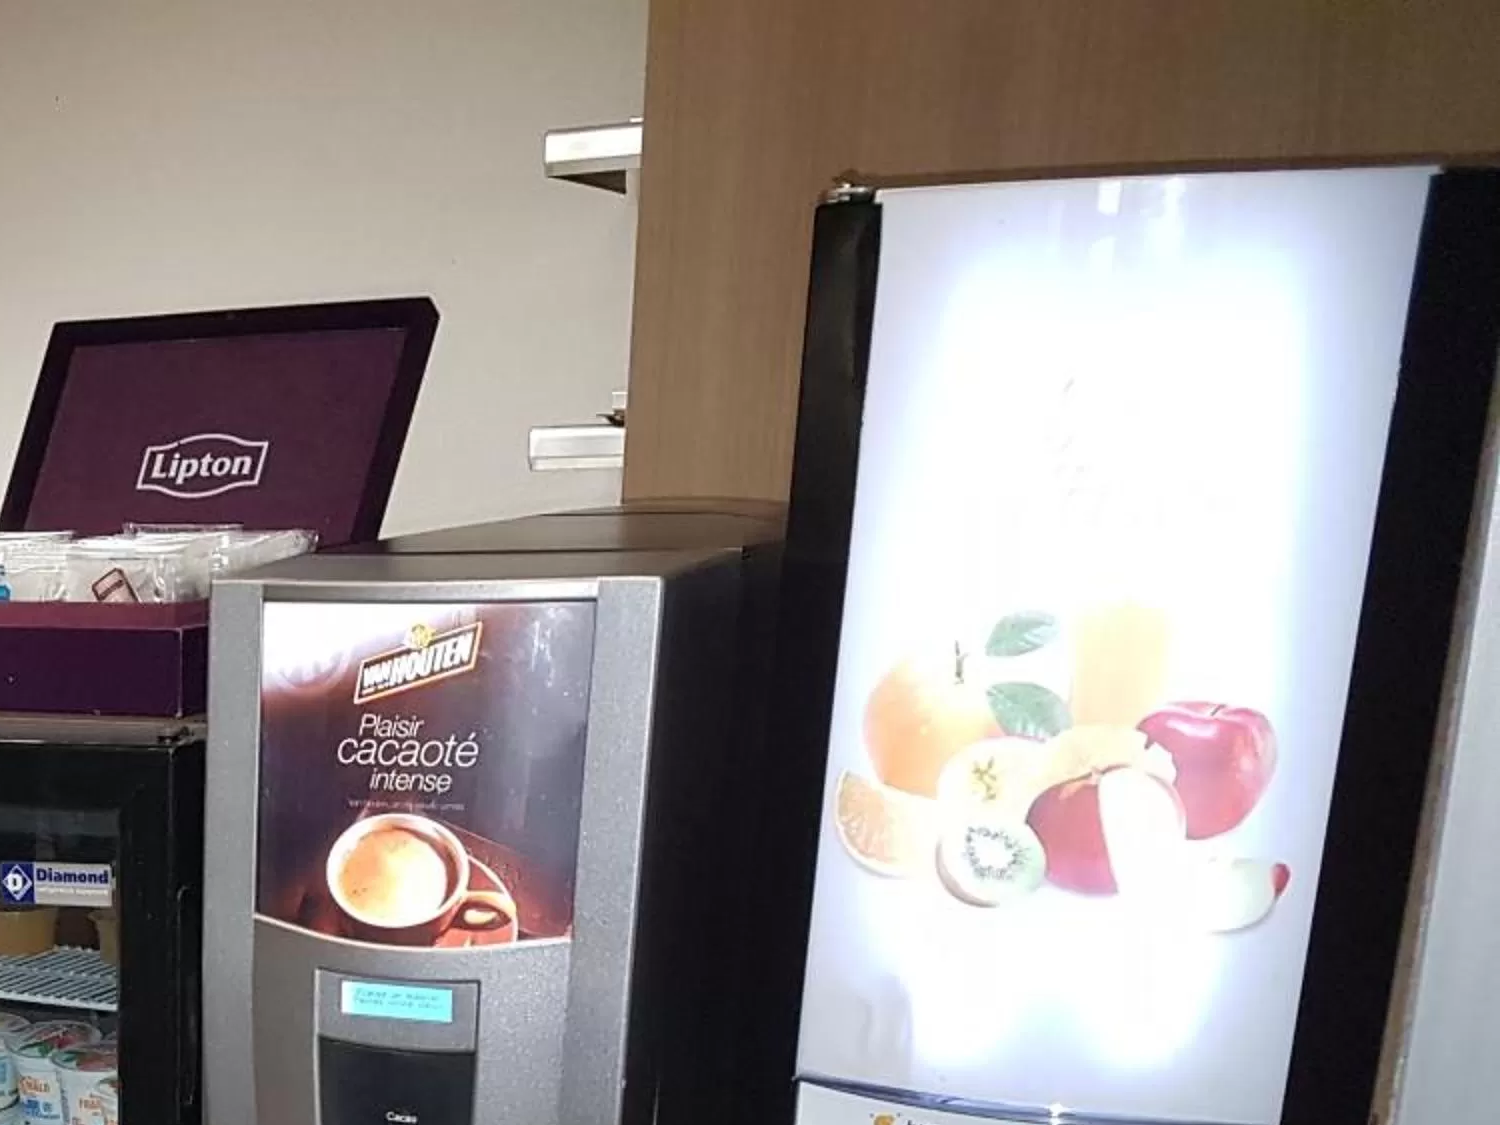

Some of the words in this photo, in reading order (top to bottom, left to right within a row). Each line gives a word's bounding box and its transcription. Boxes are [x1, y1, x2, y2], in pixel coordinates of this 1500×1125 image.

[151, 452, 253, 486] Lipton
[389, 631, 475, 686] HOUTEN
[359, 713, 425, 738] Plaisir
[337, 732, 479, 768] cacaoté
[369, 767, 452, 792] intense
[36, 868, 109, 885] Diamond
